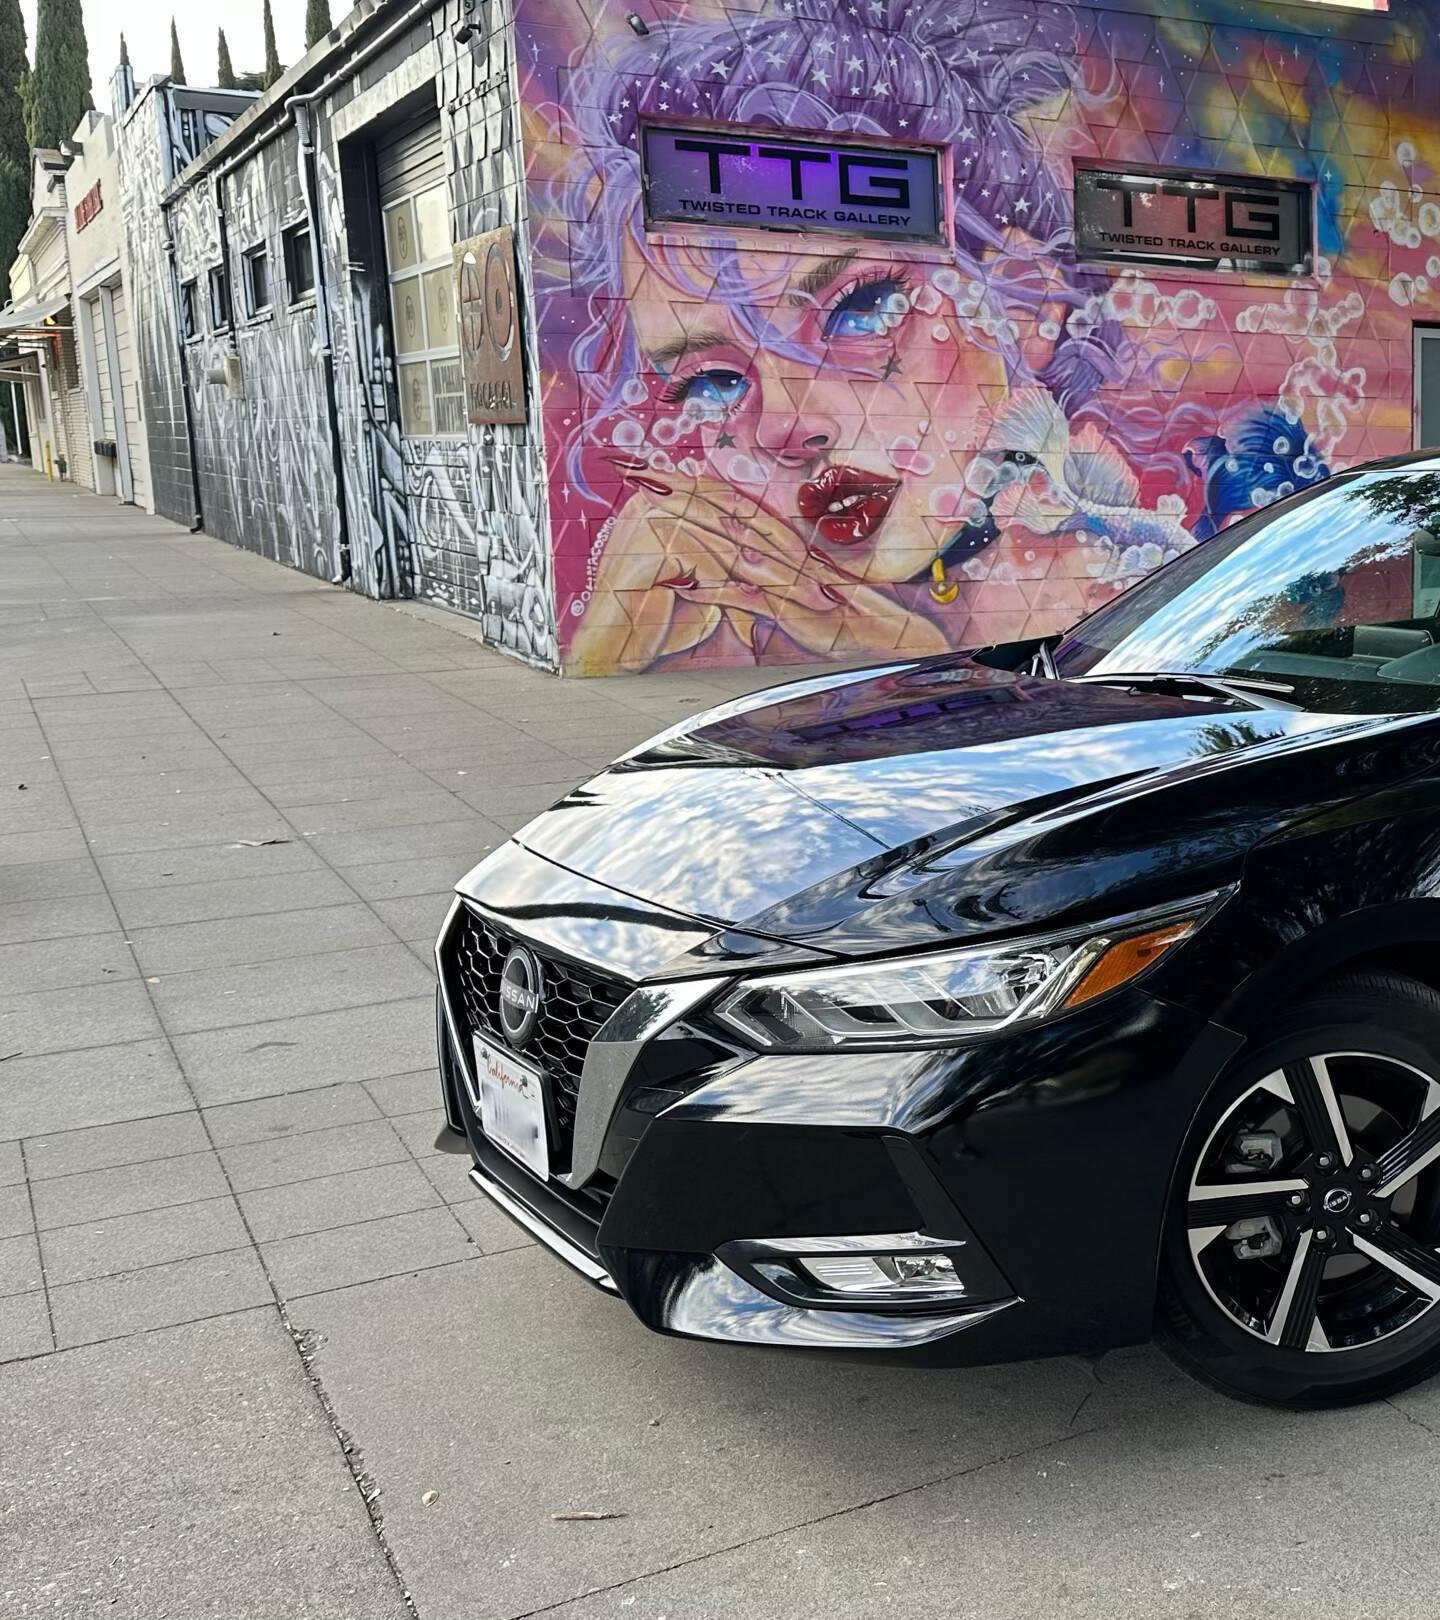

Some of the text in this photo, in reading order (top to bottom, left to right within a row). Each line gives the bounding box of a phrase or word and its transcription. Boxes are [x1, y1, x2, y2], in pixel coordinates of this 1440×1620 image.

[674, 139, 910, 209] TTG
[679, 199, 911, 226] TWISTED TRACK GALLERY
[1096, 179, 1280, 241] TTG
[1099, 232, 1281, 256] TWISTED TRACK GALLERY
